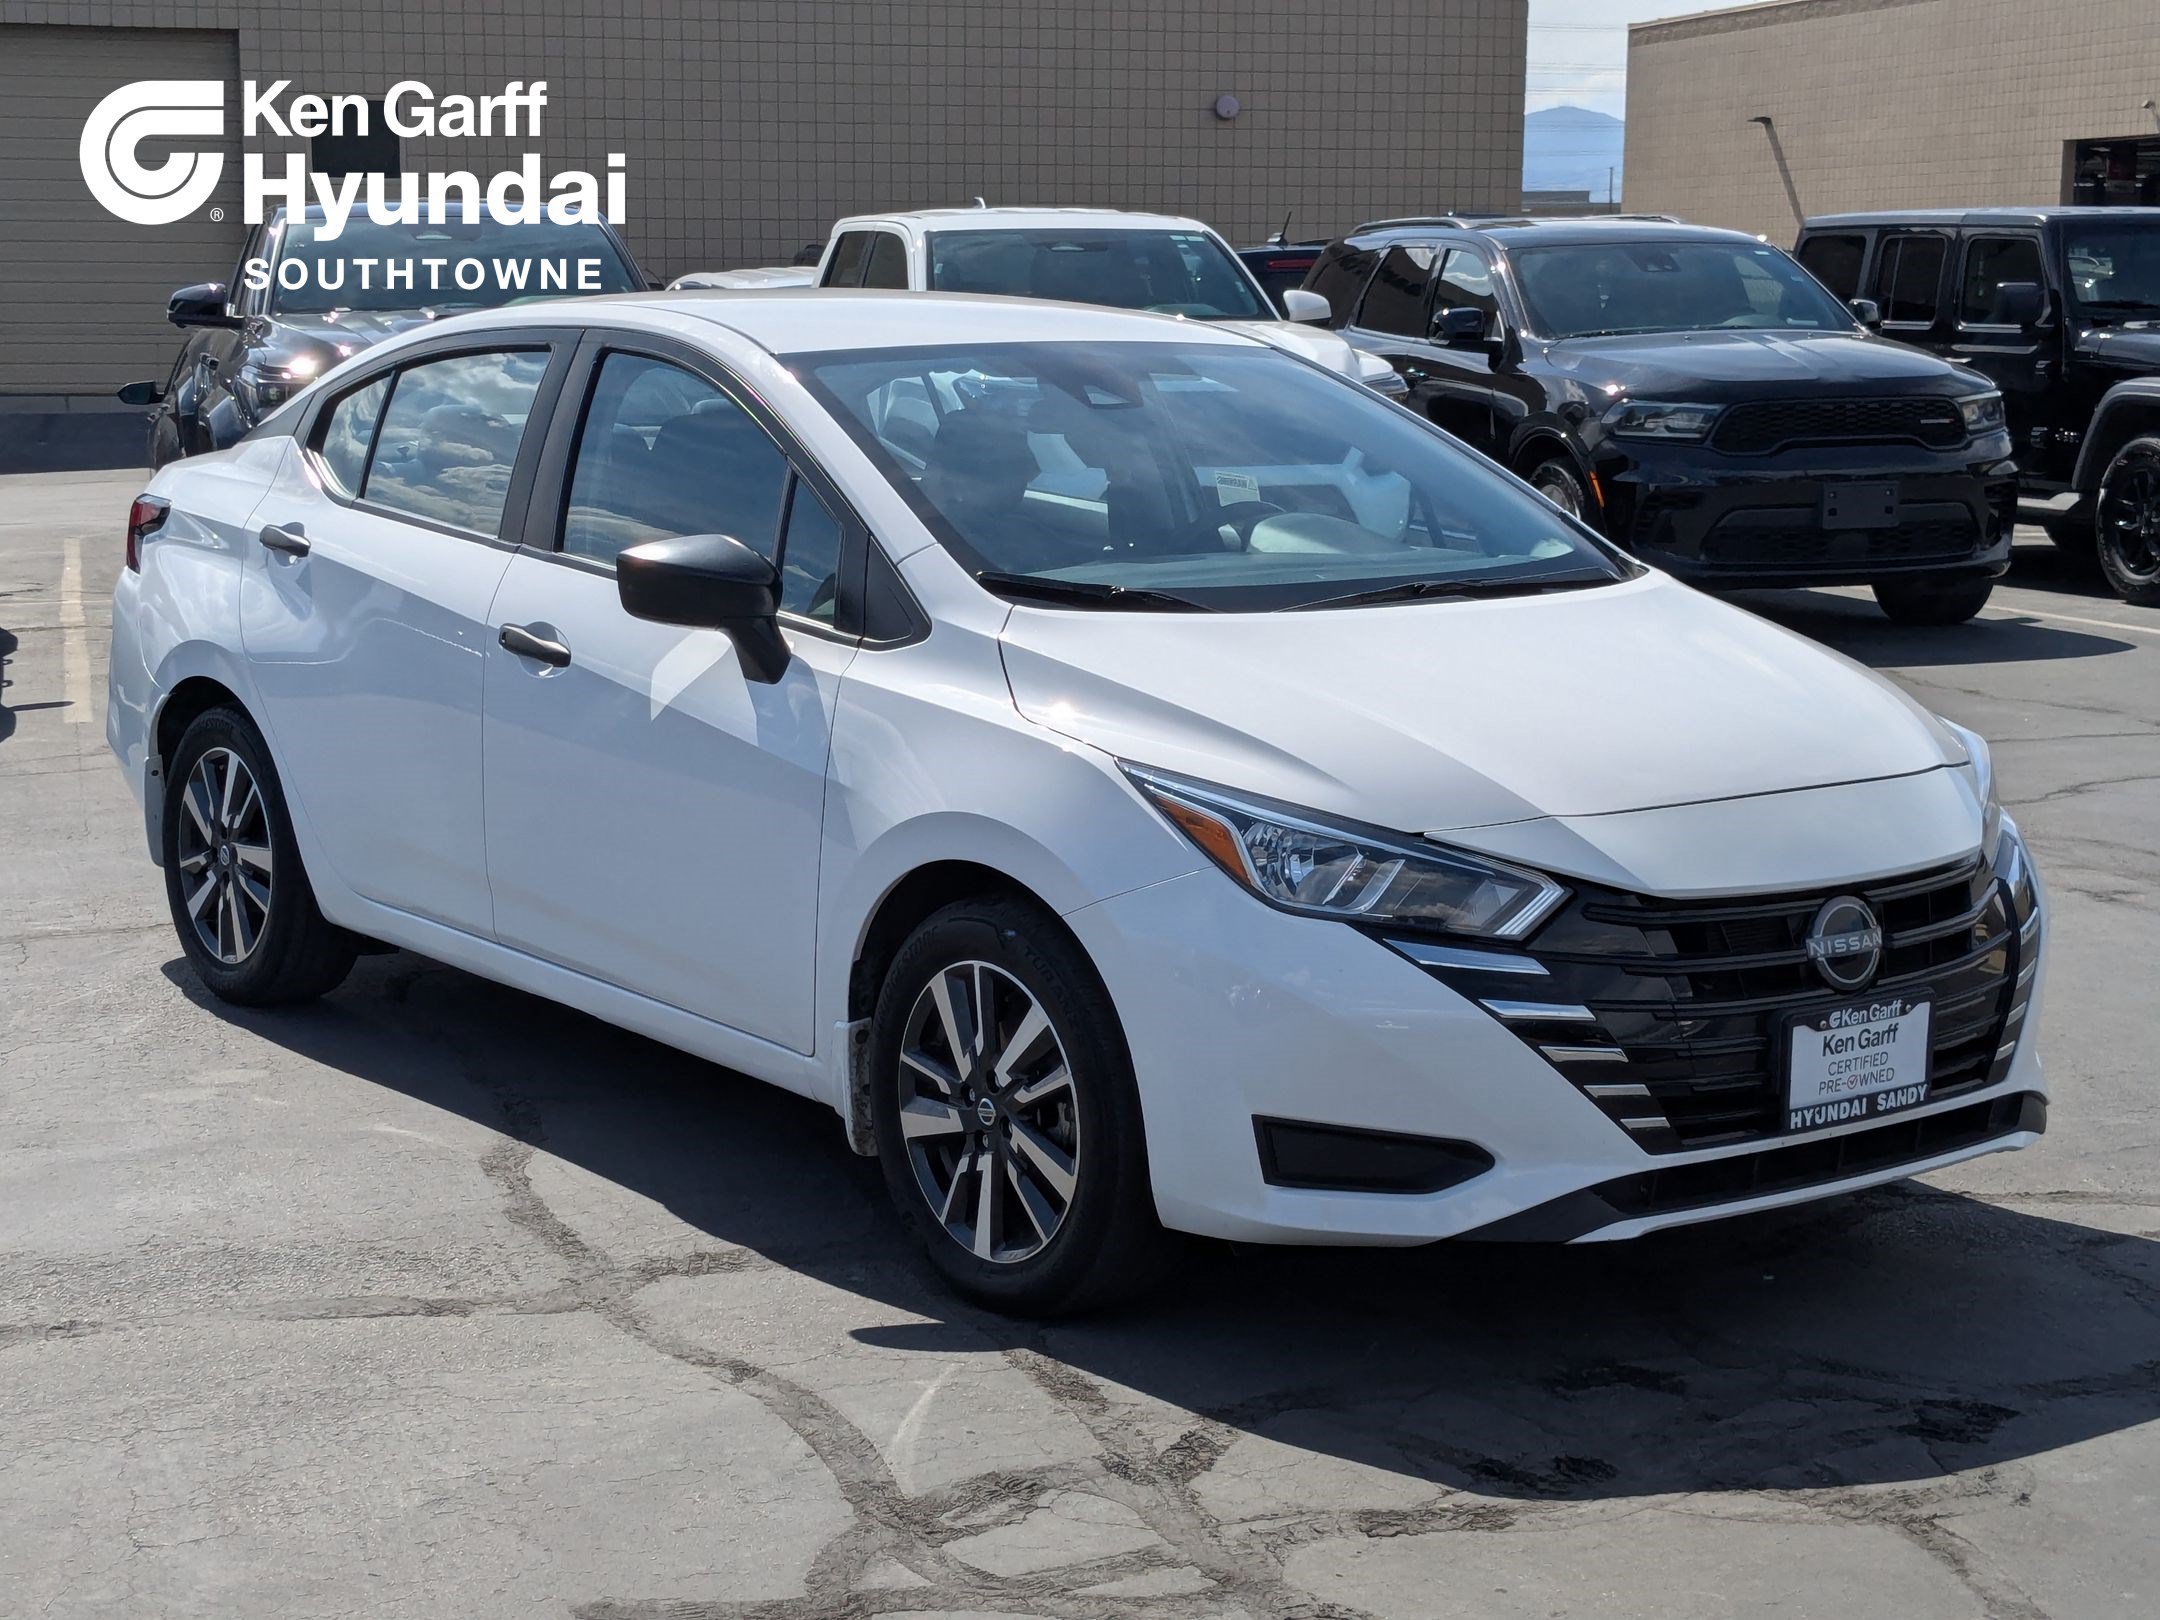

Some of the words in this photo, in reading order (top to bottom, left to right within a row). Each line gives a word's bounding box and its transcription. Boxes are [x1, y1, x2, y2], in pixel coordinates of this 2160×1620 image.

[1809, 930, 1881, 956] NISSAN
[1841, 1007, 1868, 1026] Ken
[1870, 1000, 1902, 1021] Garff
[1822, 1033, 1855, 1057] Ken
[1858, 1022, 1899, 1050] Garff
[1828, 1052, 1889, 1075] CERTIFIED
[1791, 1098, 1867, 1129] HYUNDAI
[1877, 1084, 1928, 1111] SANDY
